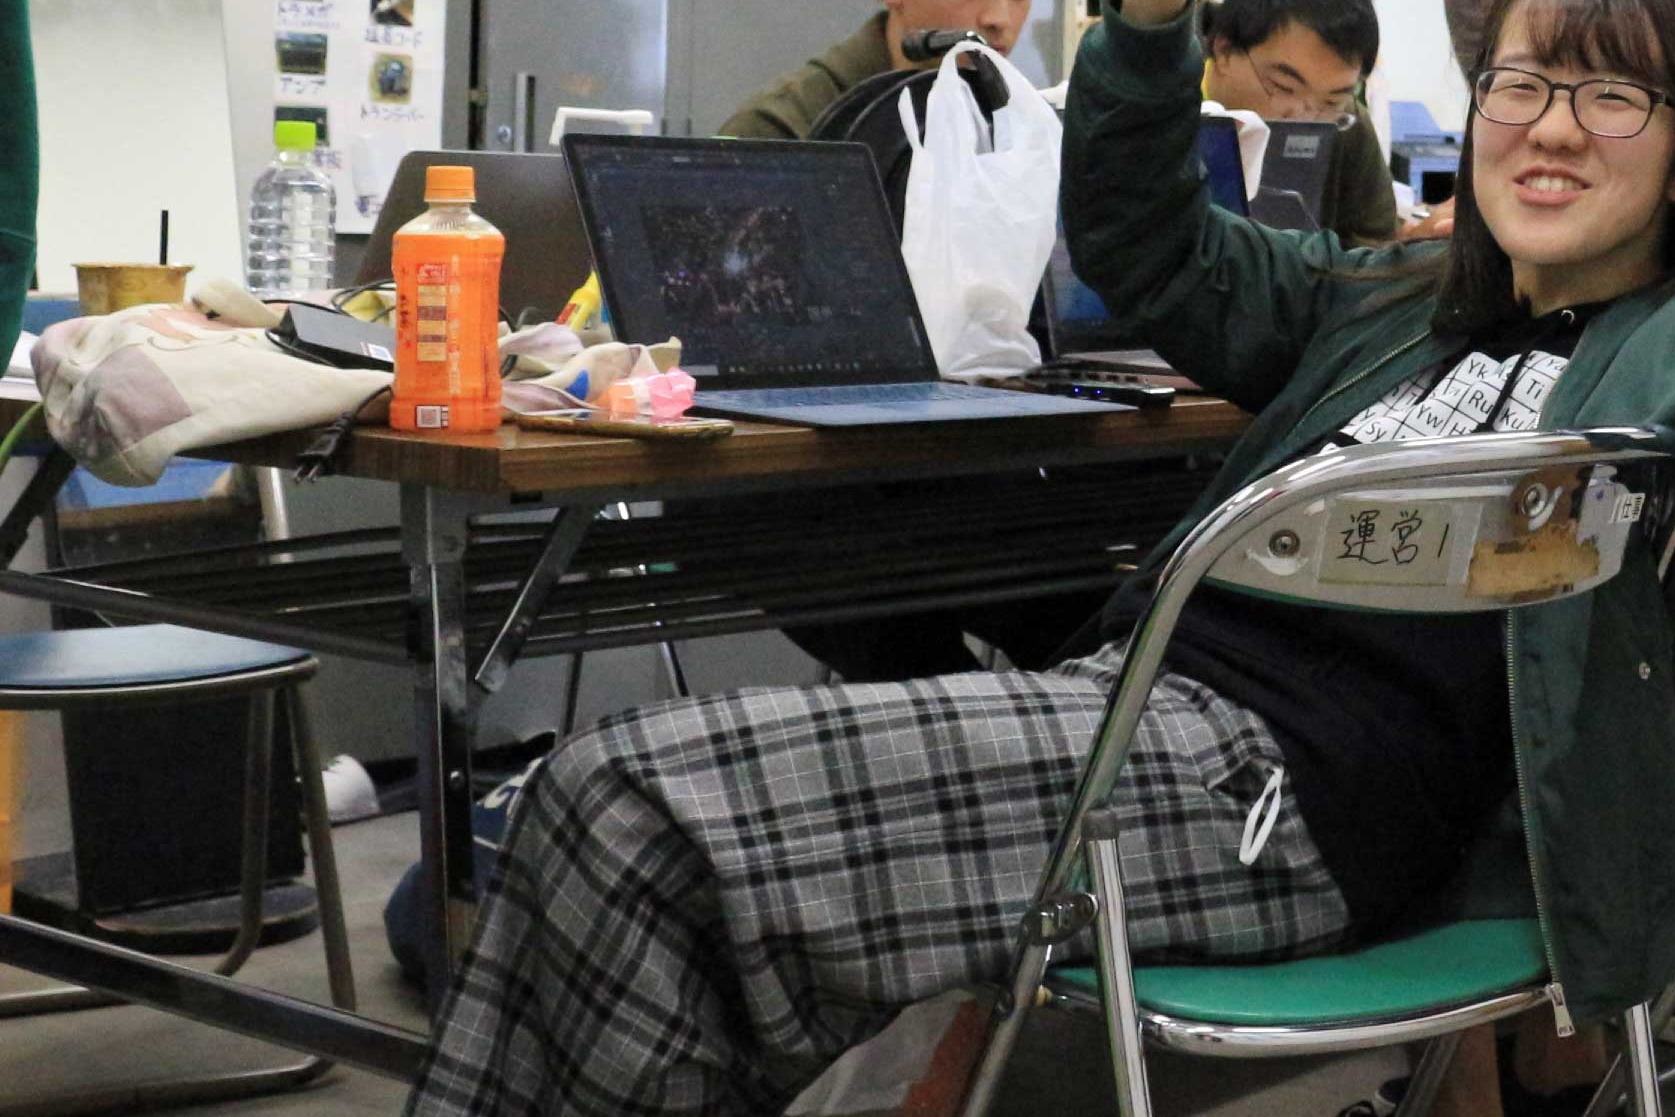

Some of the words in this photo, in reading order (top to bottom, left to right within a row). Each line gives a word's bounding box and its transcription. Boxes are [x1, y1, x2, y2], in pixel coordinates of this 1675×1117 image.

[1468, 358, 1488, 380] Yk
[1526, 377, 1545, 400] Ti
[1468, 389, 1494, 415] Ru
[1416, 404, 1444, 429] Yw
[1499, 407, 1525, 430] Ku
[1365, 421, 1387, 443] Sy
